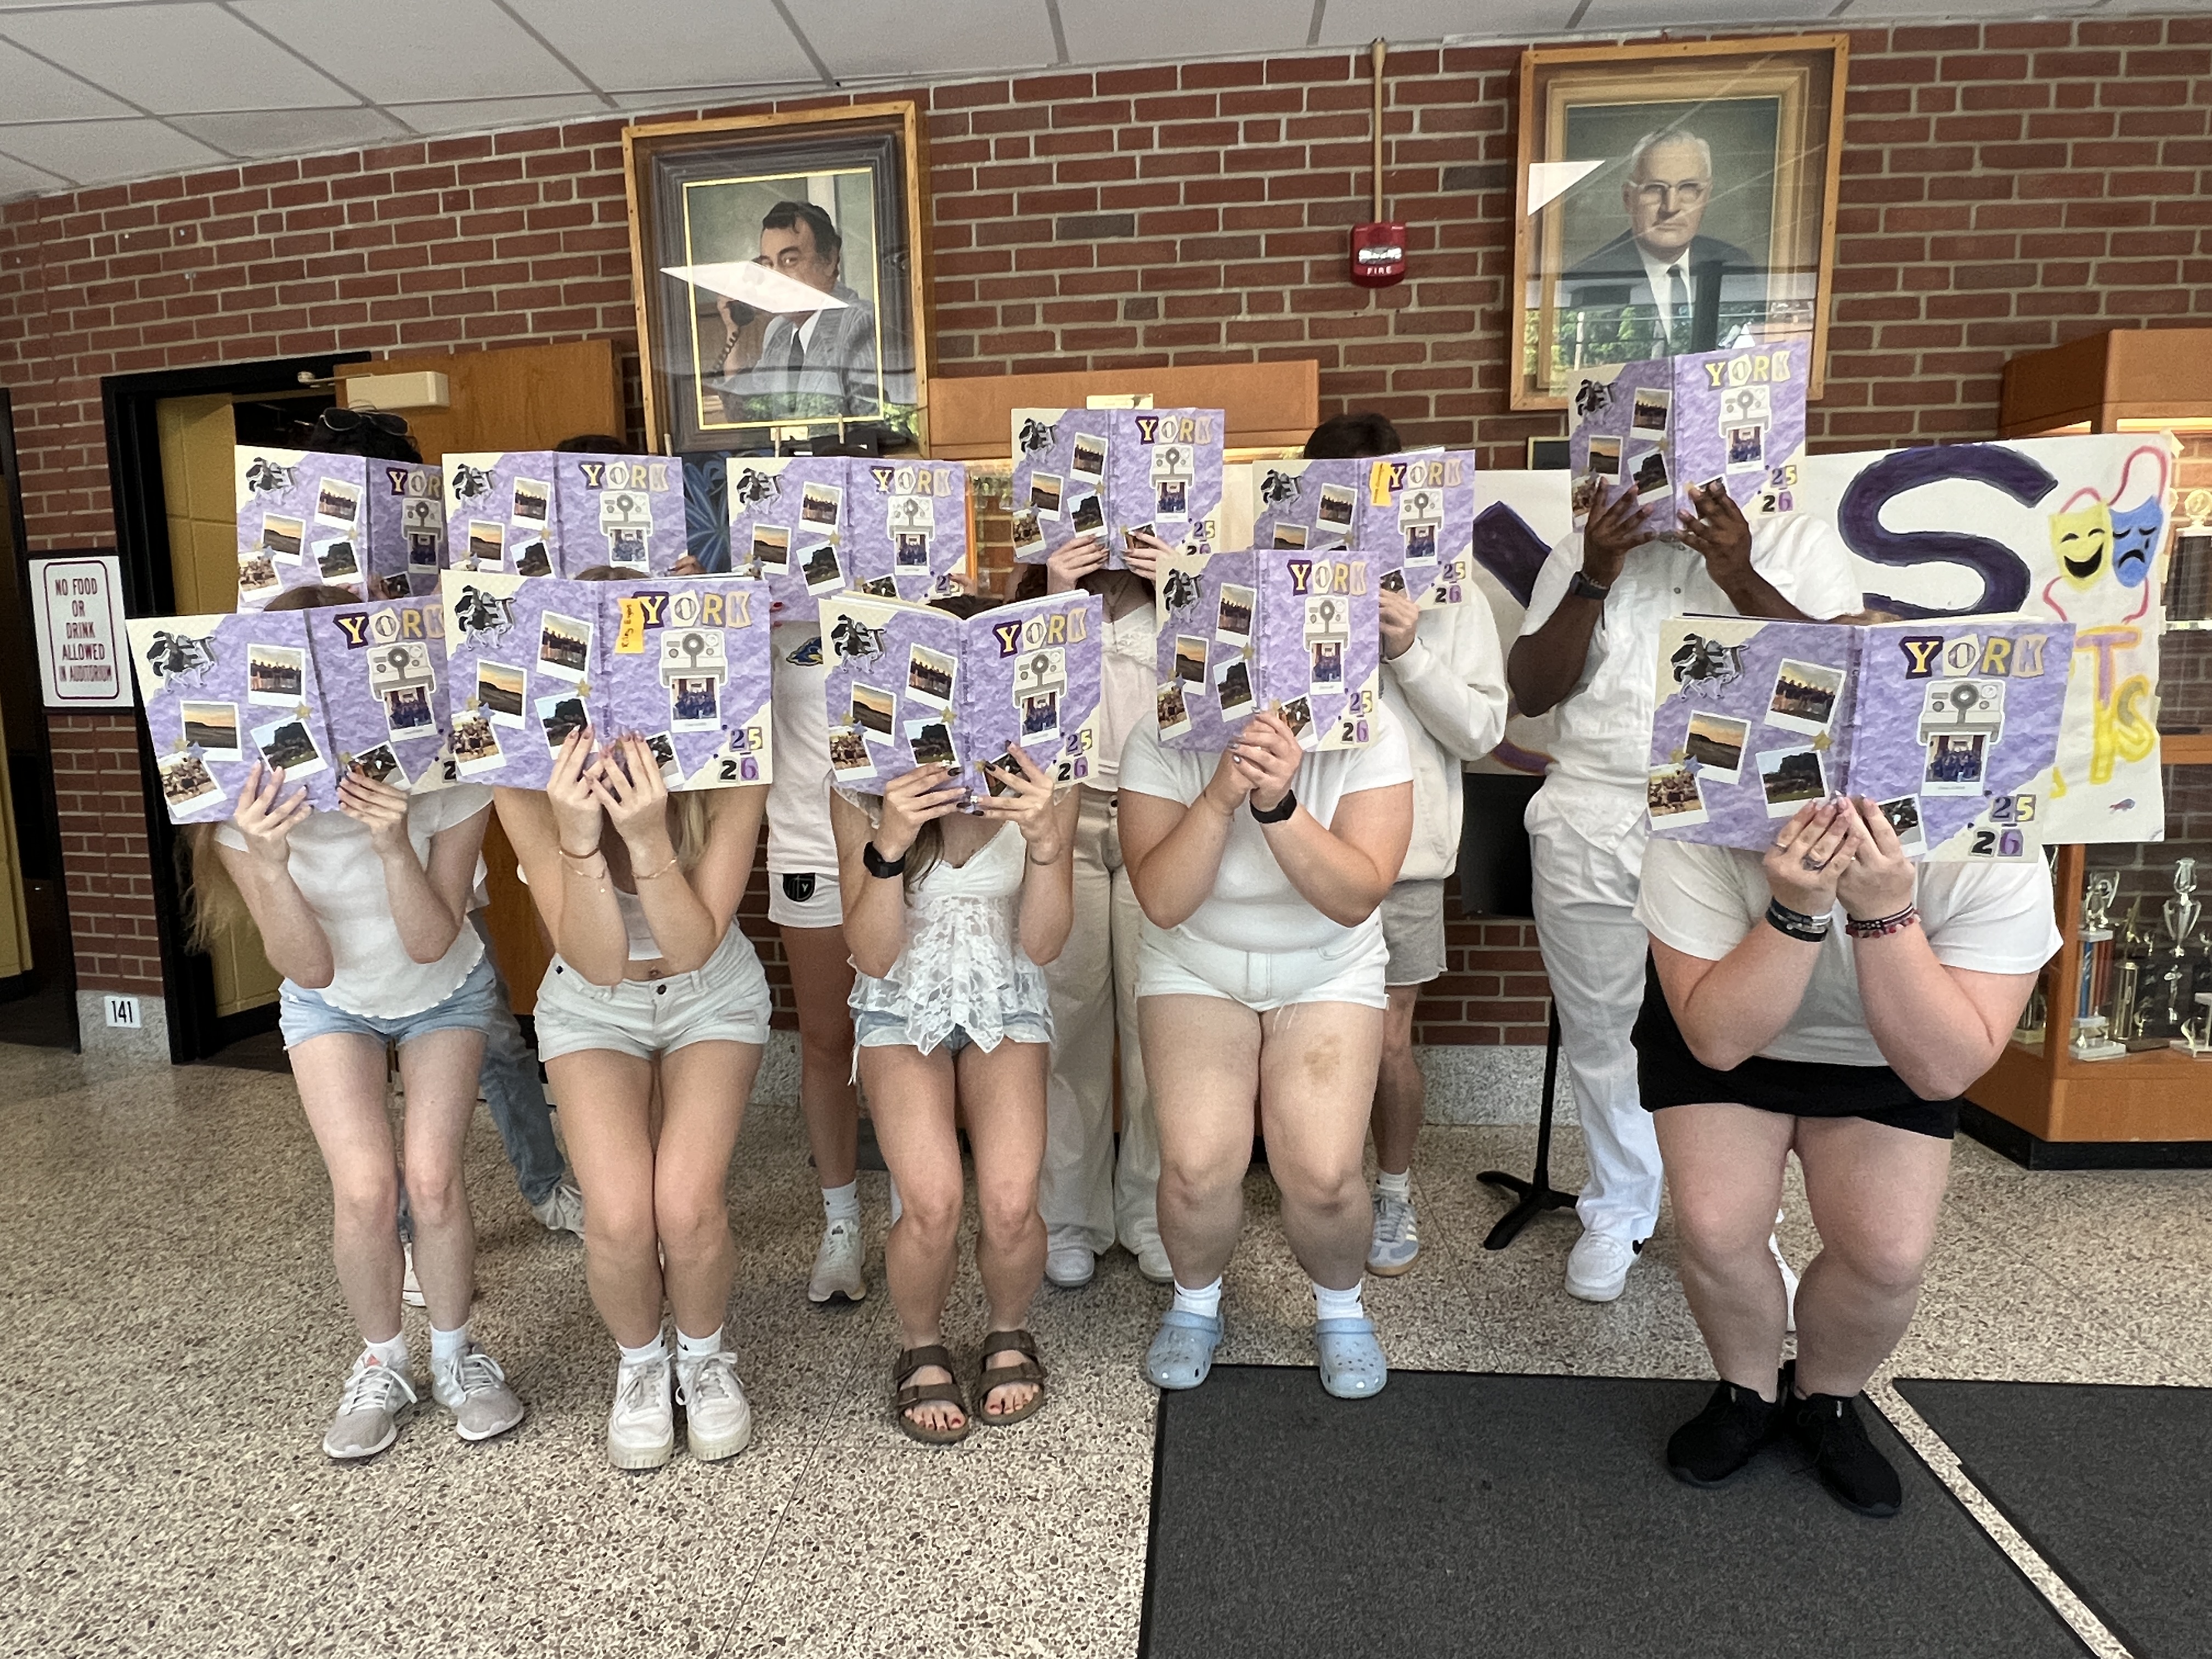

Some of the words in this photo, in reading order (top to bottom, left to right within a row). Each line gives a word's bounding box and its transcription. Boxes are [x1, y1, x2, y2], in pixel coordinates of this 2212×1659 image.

[1367, 266, 1392, 275] FIRE
[1706, 353, 1790, 388] YORK
[1137, 416, 1212, 444] YORK
[387, 469, 441, 498] YOR
[580, 462, 667, 490] YORK
[871, 467, 950, 495] YORK
[1390, 460, 1462, 491] YORK
[1773, 466, 1796, 484] 25
[1762, 494, 1793, 512] 26
[1194, 522, 1215, 538] 25
[1288, 561, 1367, 595] YORK
[1444, 563, 1465, 580] 25
[55, 579, 68, 596] NO
[73, 578, 98, 595] FOOD
[1436, 585, 1462, 603] 26
[72, 600, 85, 617] OR
[635, 592, 750, 628] YORK
[66, 622, 95, 639] DRINK
[995, 610, 1086, 657] YORK
[61, 643, 105, 661] ALLOWED
[1900, 636, 2046, 678] YORK
[59, 665, 67, 682] IN
[1350, 692, 1372, 712] 25
[731, 729, 761, 751] 25
[1066, 730, 1092, 753] 25
[1342, 722, 1368, 742] 26
[443, 760, 456, 780] 2
[720, 758, 759, 780] 26
[1058, 759, 1088, 781] 26
[1992, 797, 2034, 821] 25
[1971, 831, 2021, 855] 26
[111, 1001, 133, 1023] 141
